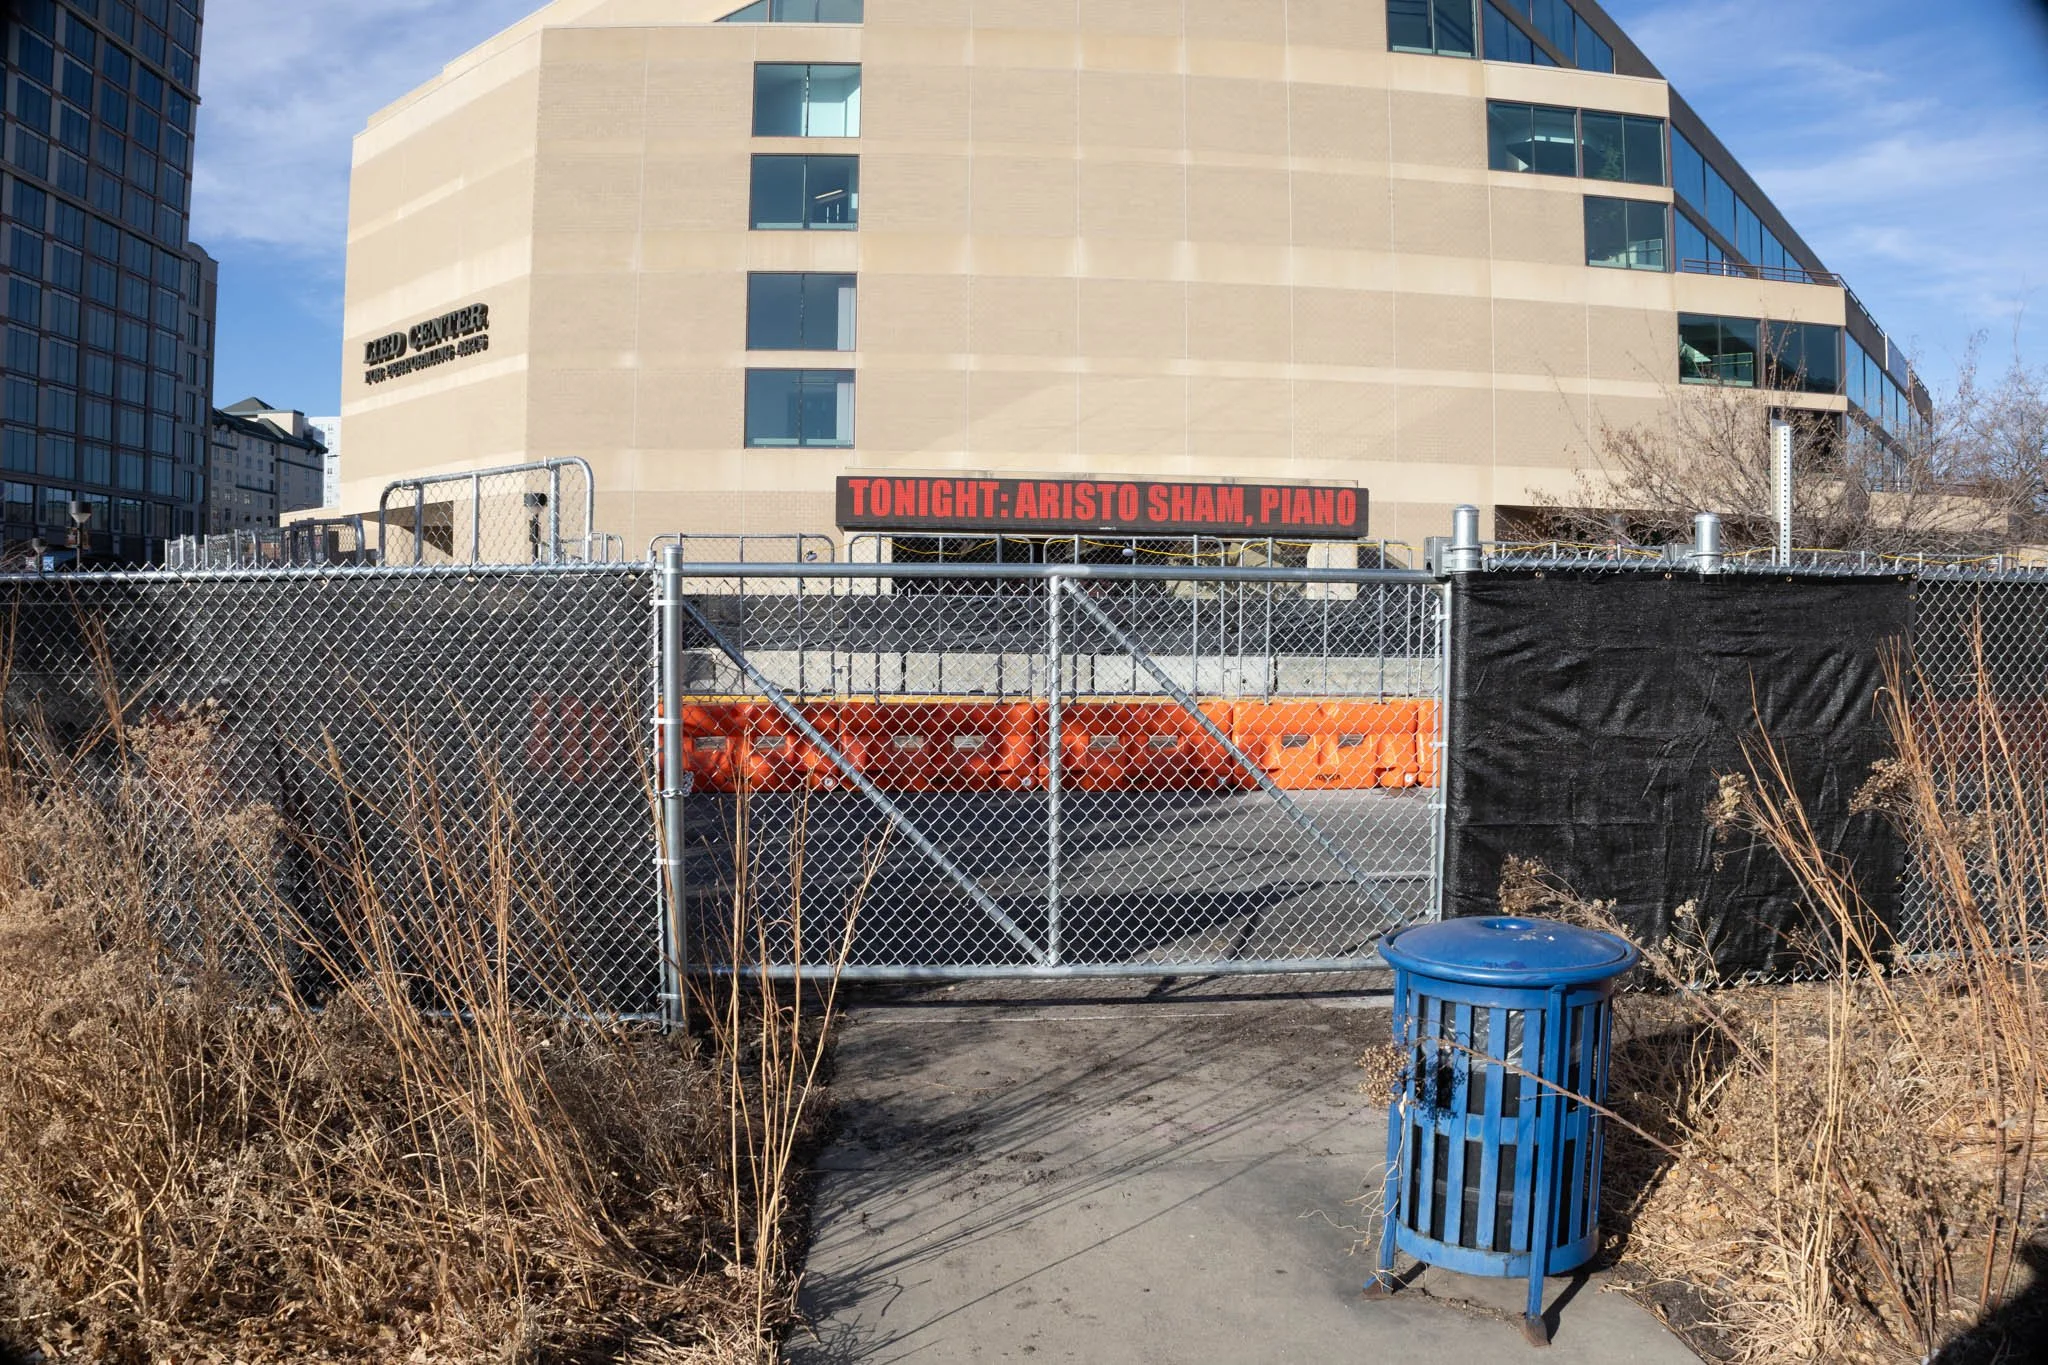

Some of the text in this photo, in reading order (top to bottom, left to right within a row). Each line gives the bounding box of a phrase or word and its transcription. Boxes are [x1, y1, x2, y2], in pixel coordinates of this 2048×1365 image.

[363, 303, 489, 366] LIED CENTER
[364, 334, 489, 385] FOR PERFORMING ARTS
[848, 478, 1357, 527] TONIGHT: ARISTO SHAM, PIANO
